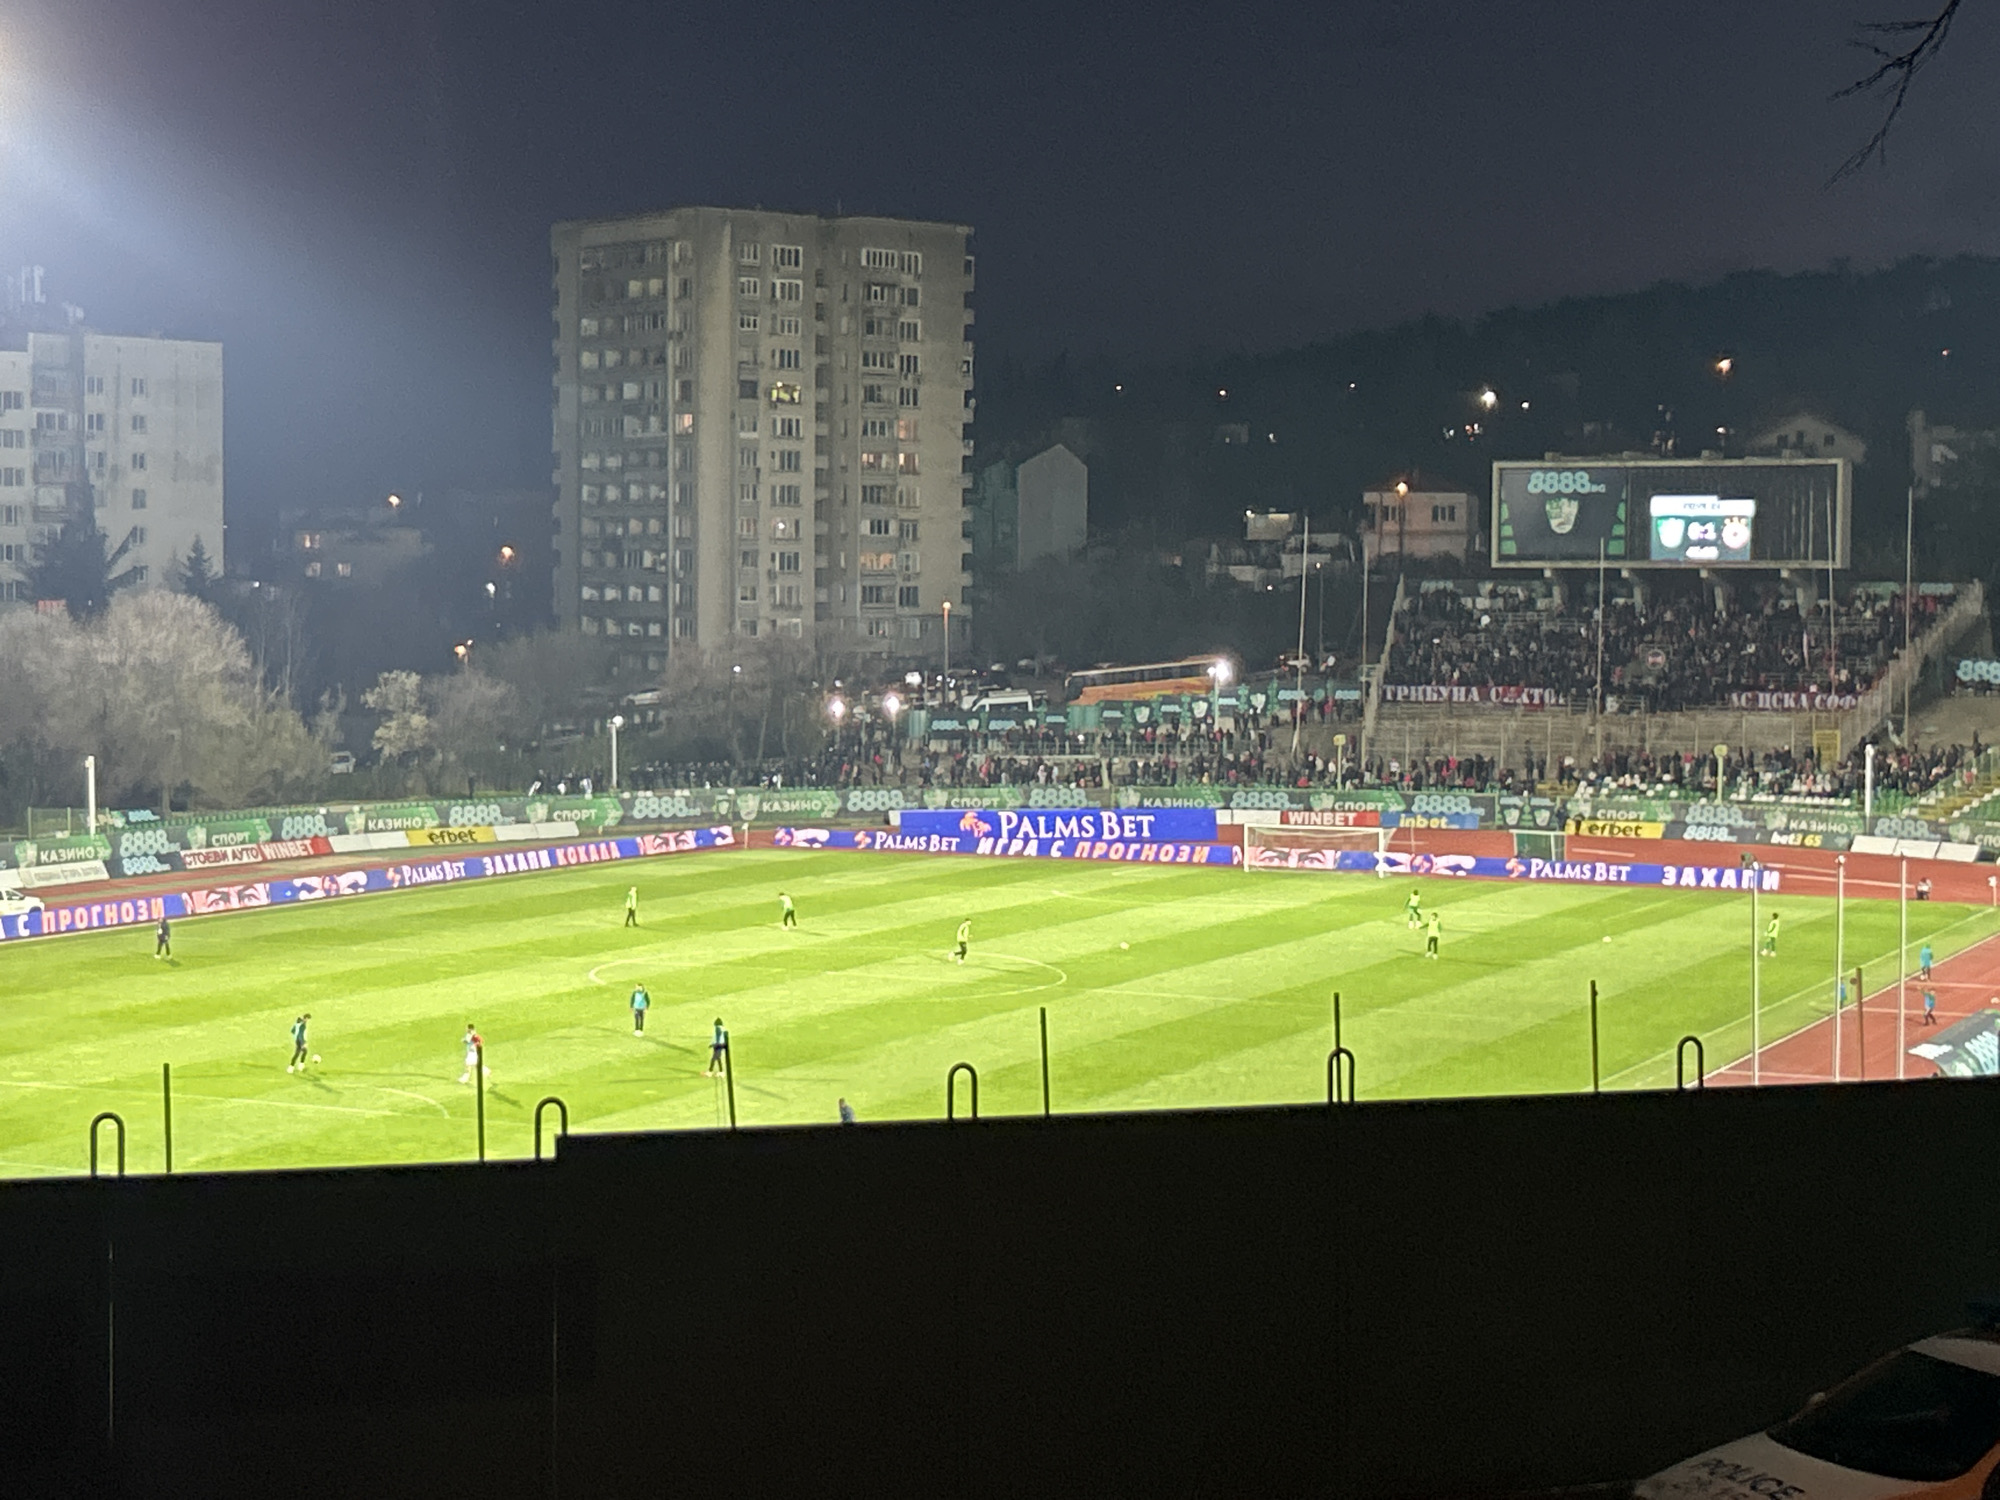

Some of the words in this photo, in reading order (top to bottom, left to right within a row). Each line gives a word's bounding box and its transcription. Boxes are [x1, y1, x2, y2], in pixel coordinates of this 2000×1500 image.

[998, 811, 1096, 839] PALMS
[1100, 811, 1155, 840] BET
[1286, 811, 1357, 826] WINBET
[427, 830, 477, 844] efbet
[875, 831, 928, 850] PALMS
[929, 834, 961, 852] BET
[1584, 824, 1643, 838] efbet
[231, 846, 260, 860] АУТО
[261, 839, 315, 861] WINBET
[976, 837, 1039, 857] ИГРА
[1074, 841, 1210, 863] ПРОГНОЗИ
[401, 864, 446, 885] PALMS
[442, 861, 466, 881] BET
[1530, 858, 1592, 879] PALMS
[1594, 862, 1631, 882] BET
[1661, 865, 1780, 891] ЗАХАПИ
[41, 897, 166, 934] ПРОГНОЗИ
